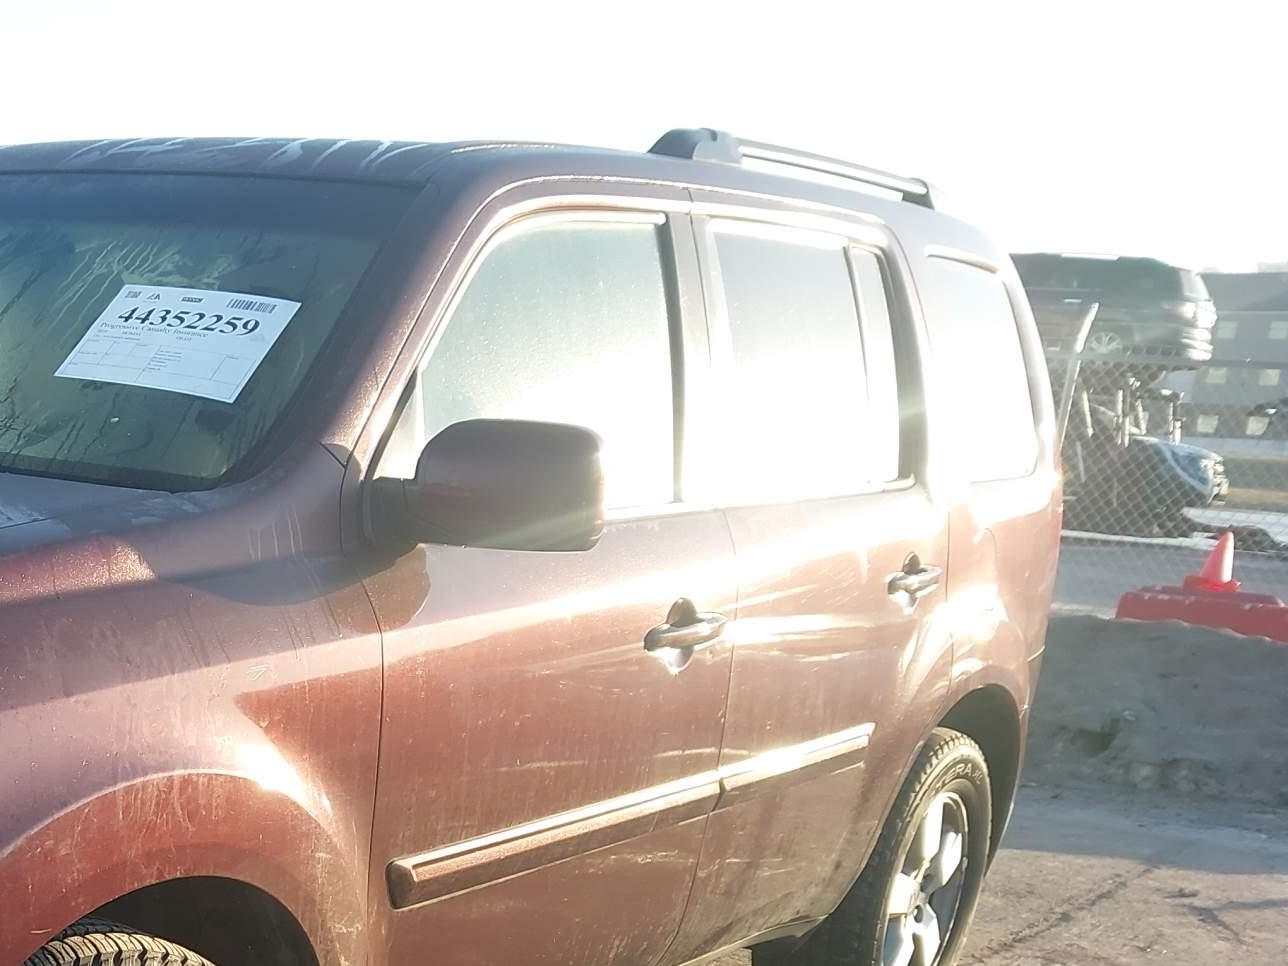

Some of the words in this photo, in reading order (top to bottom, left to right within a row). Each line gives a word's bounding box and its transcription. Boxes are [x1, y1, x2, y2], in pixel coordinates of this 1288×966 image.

[100, 321, 139, 331] Progressive
[141, 324, 171, 334] Casualty
[173, 329, 208, 338] Insurance
[118, 306, 260, 336] 44352259
